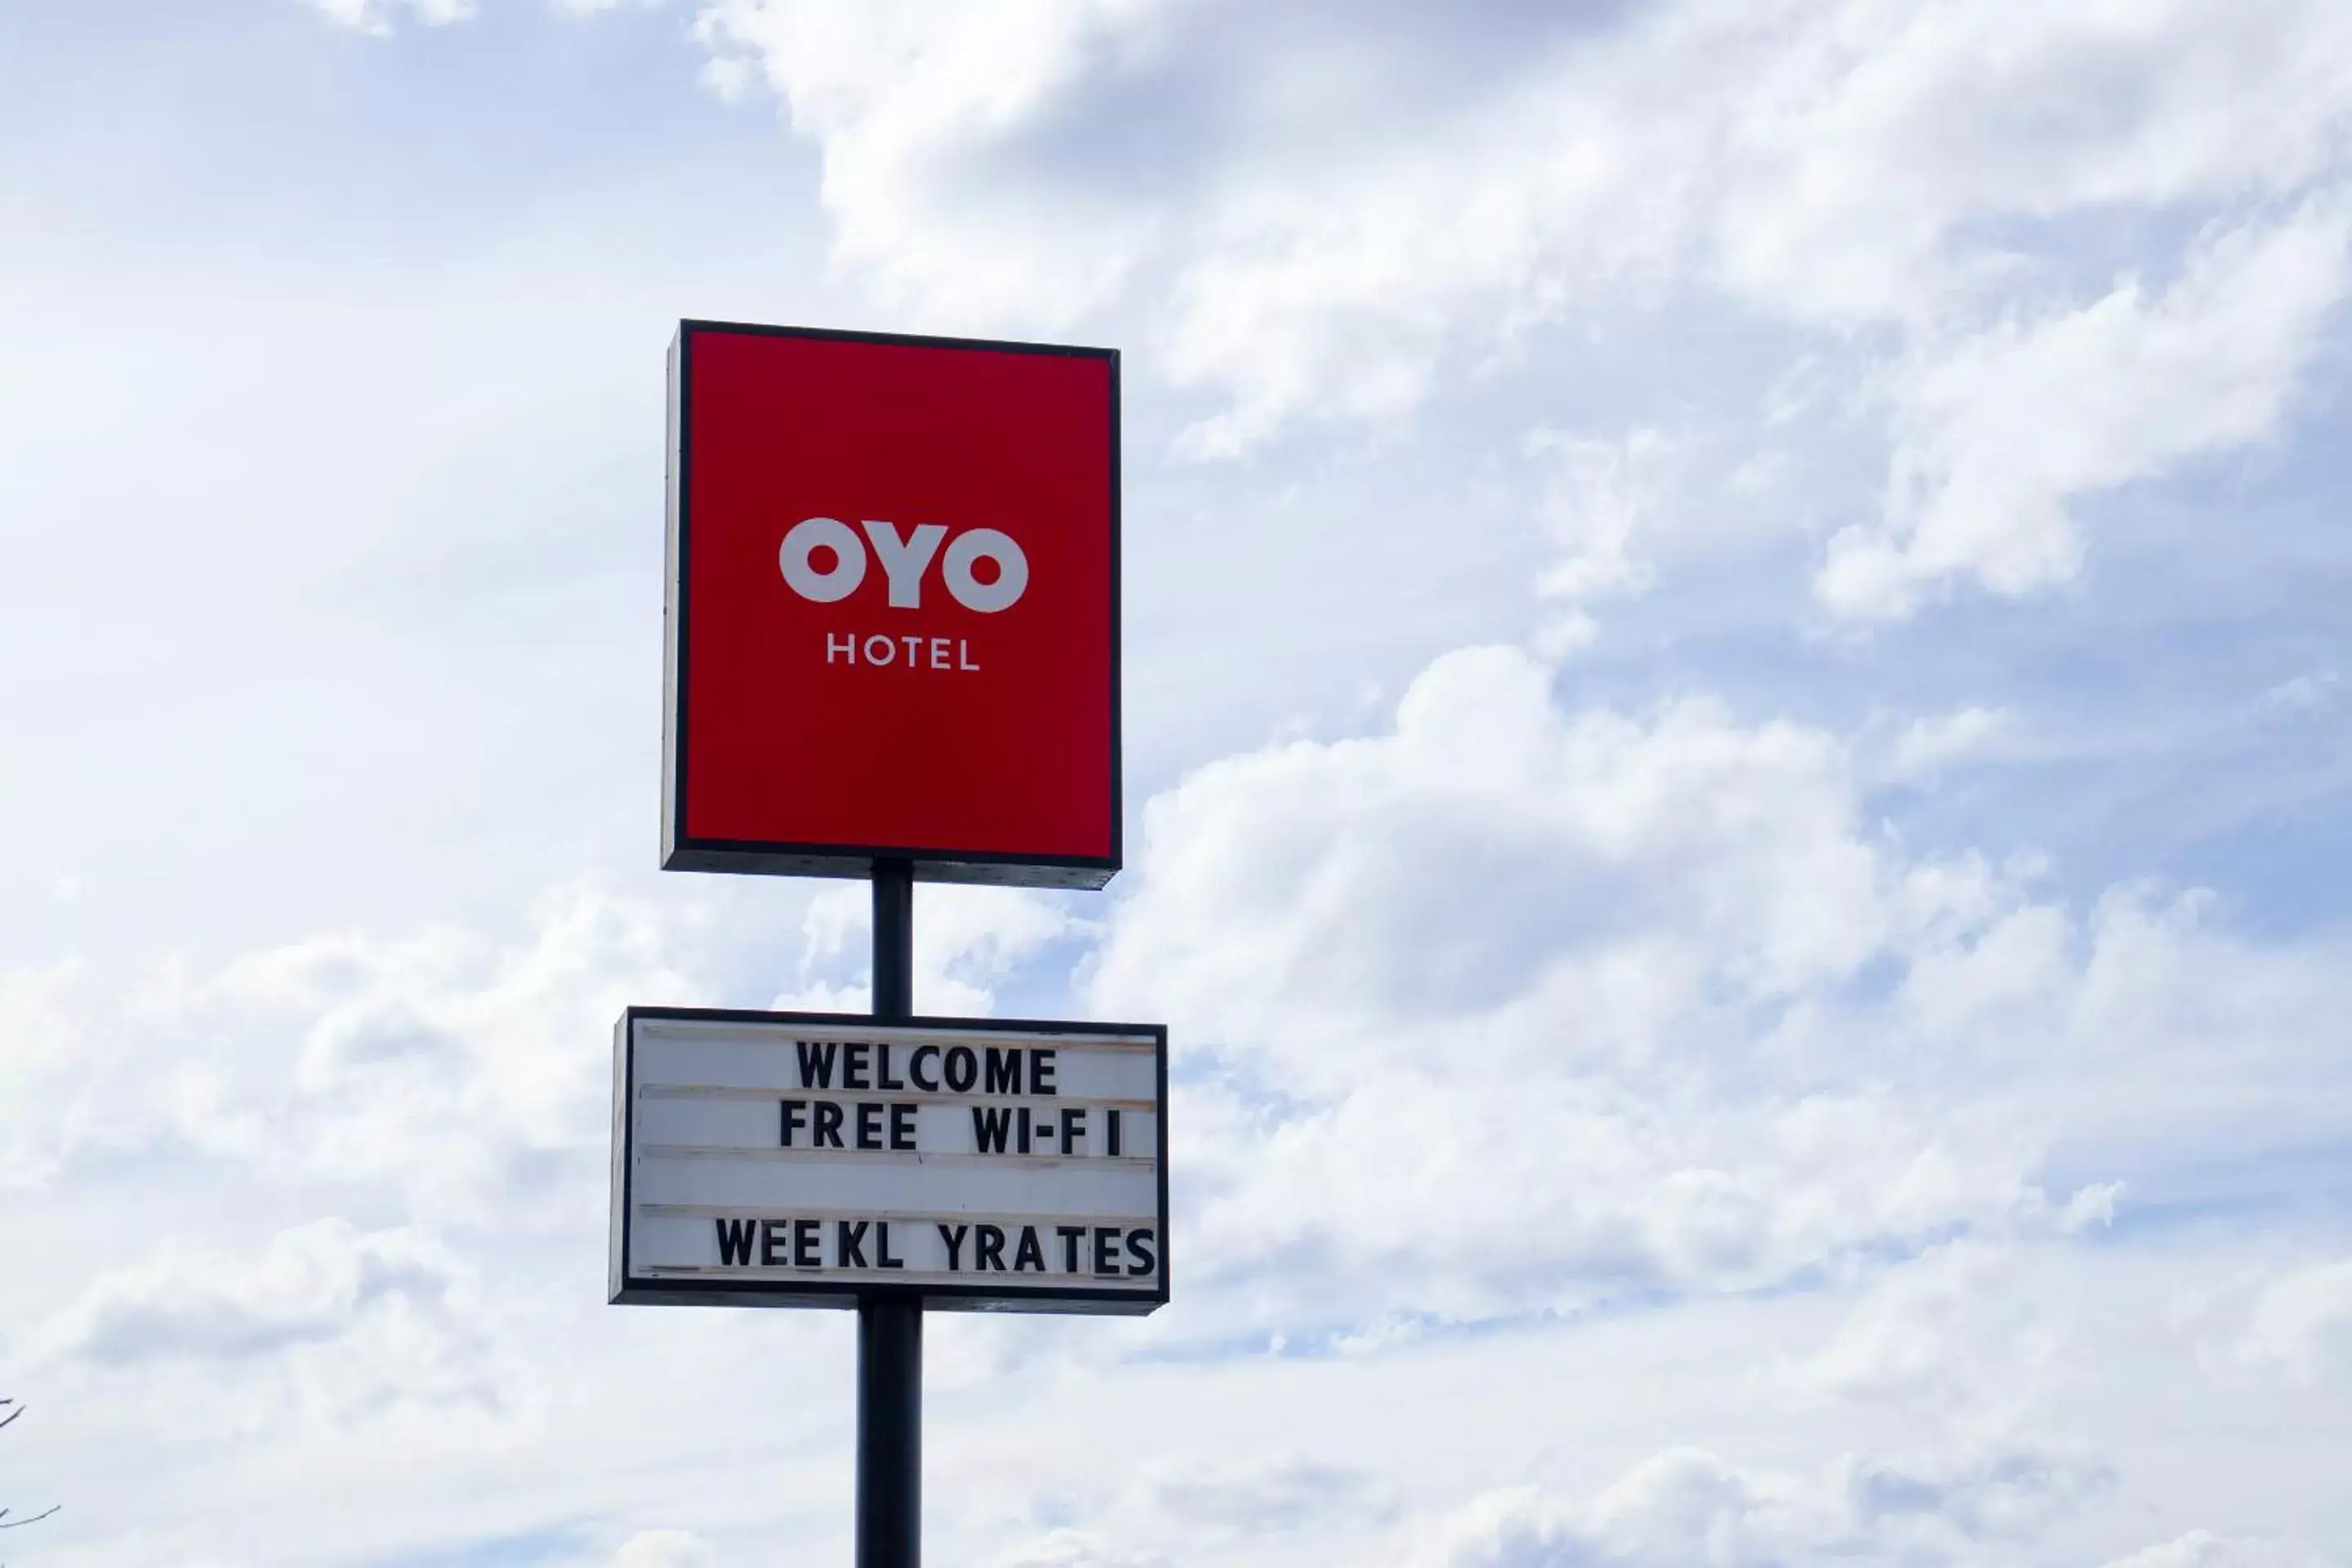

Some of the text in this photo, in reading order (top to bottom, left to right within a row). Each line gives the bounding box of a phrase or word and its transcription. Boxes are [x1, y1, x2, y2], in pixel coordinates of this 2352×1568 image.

[779, 517, 1029, 612] OYO
[827, 633, 980, 670] HOTEL
[796, 1041, 1056, 1094] WELCOME
[780, 1100, 1120, 1156] FREE WI-FI
